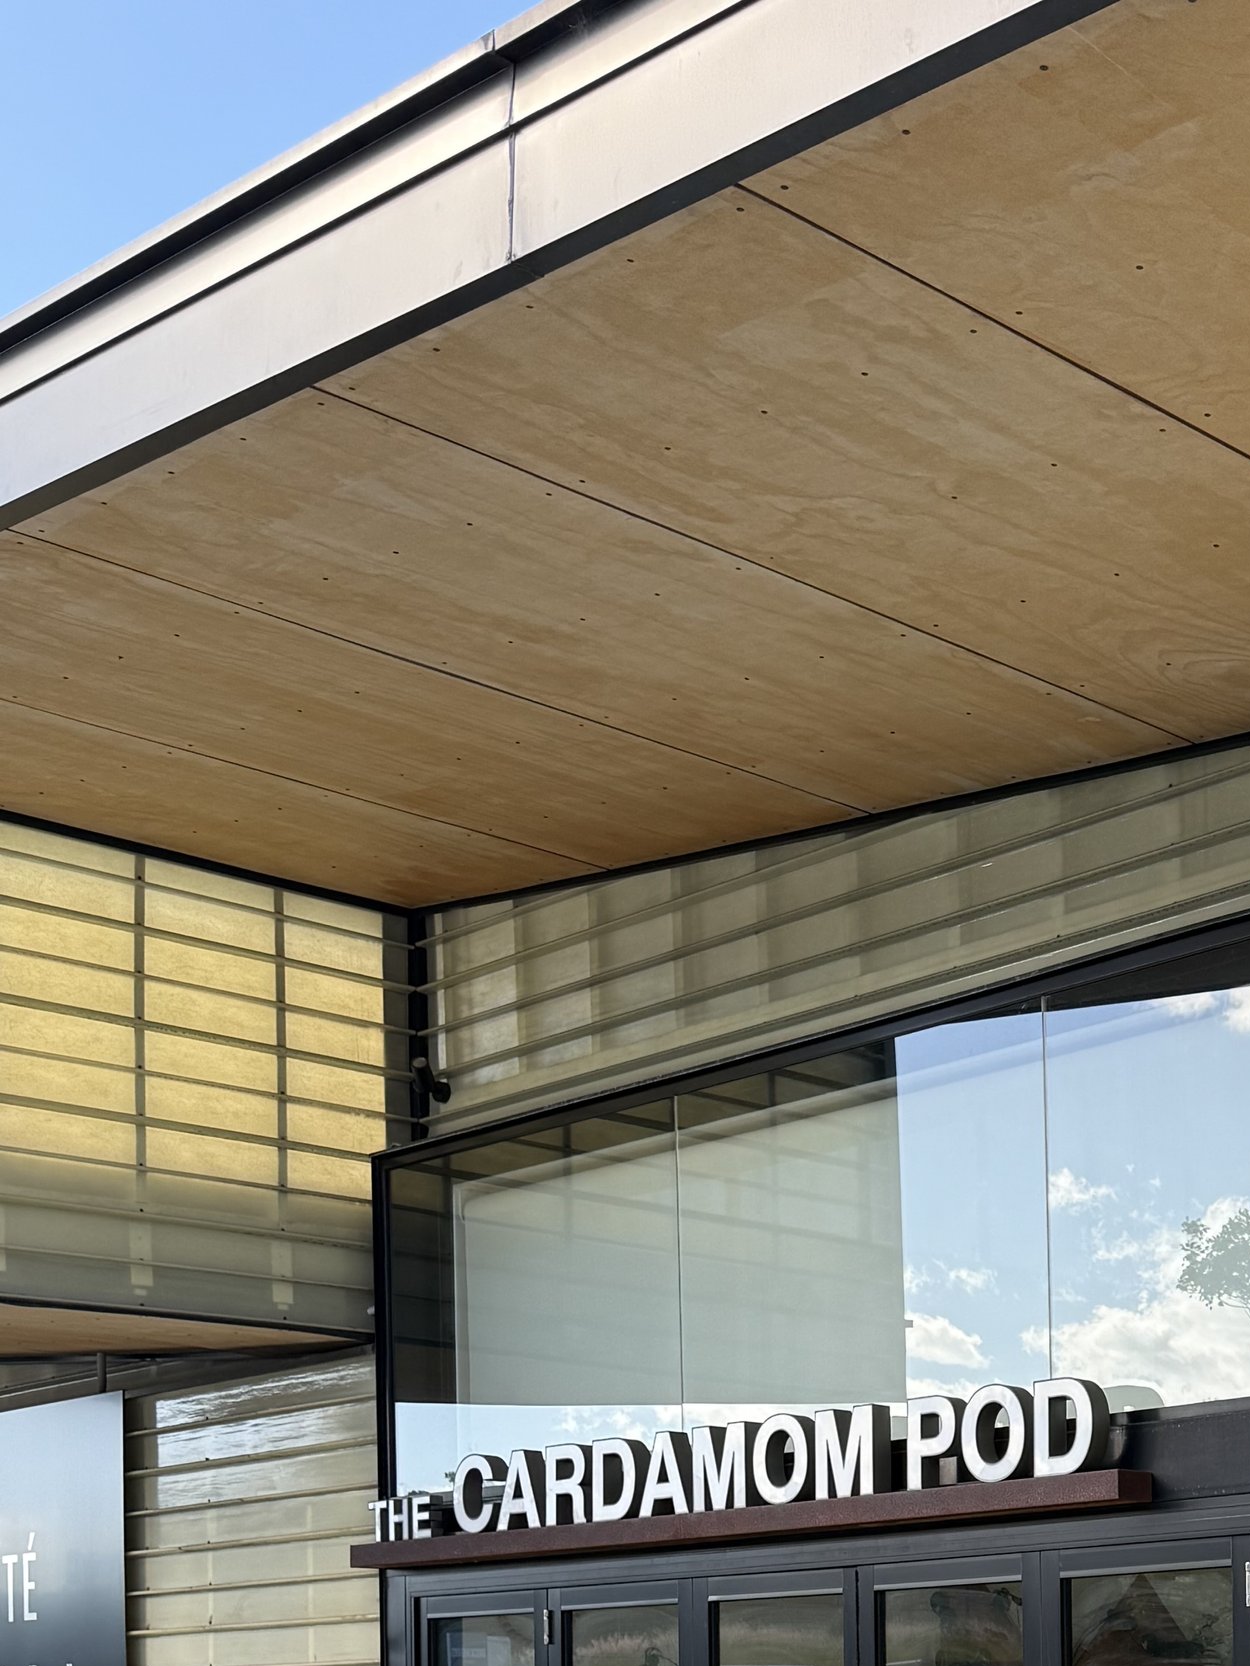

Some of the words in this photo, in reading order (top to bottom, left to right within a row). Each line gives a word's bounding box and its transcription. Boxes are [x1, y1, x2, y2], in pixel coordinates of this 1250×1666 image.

[368, 1497, 433, 1543] THE
[453, 1404, 874, 1534] CARDAMOM
[906, 1378, 1093, 1490] POD
[2, 1532, 37, 1622] TÉ
